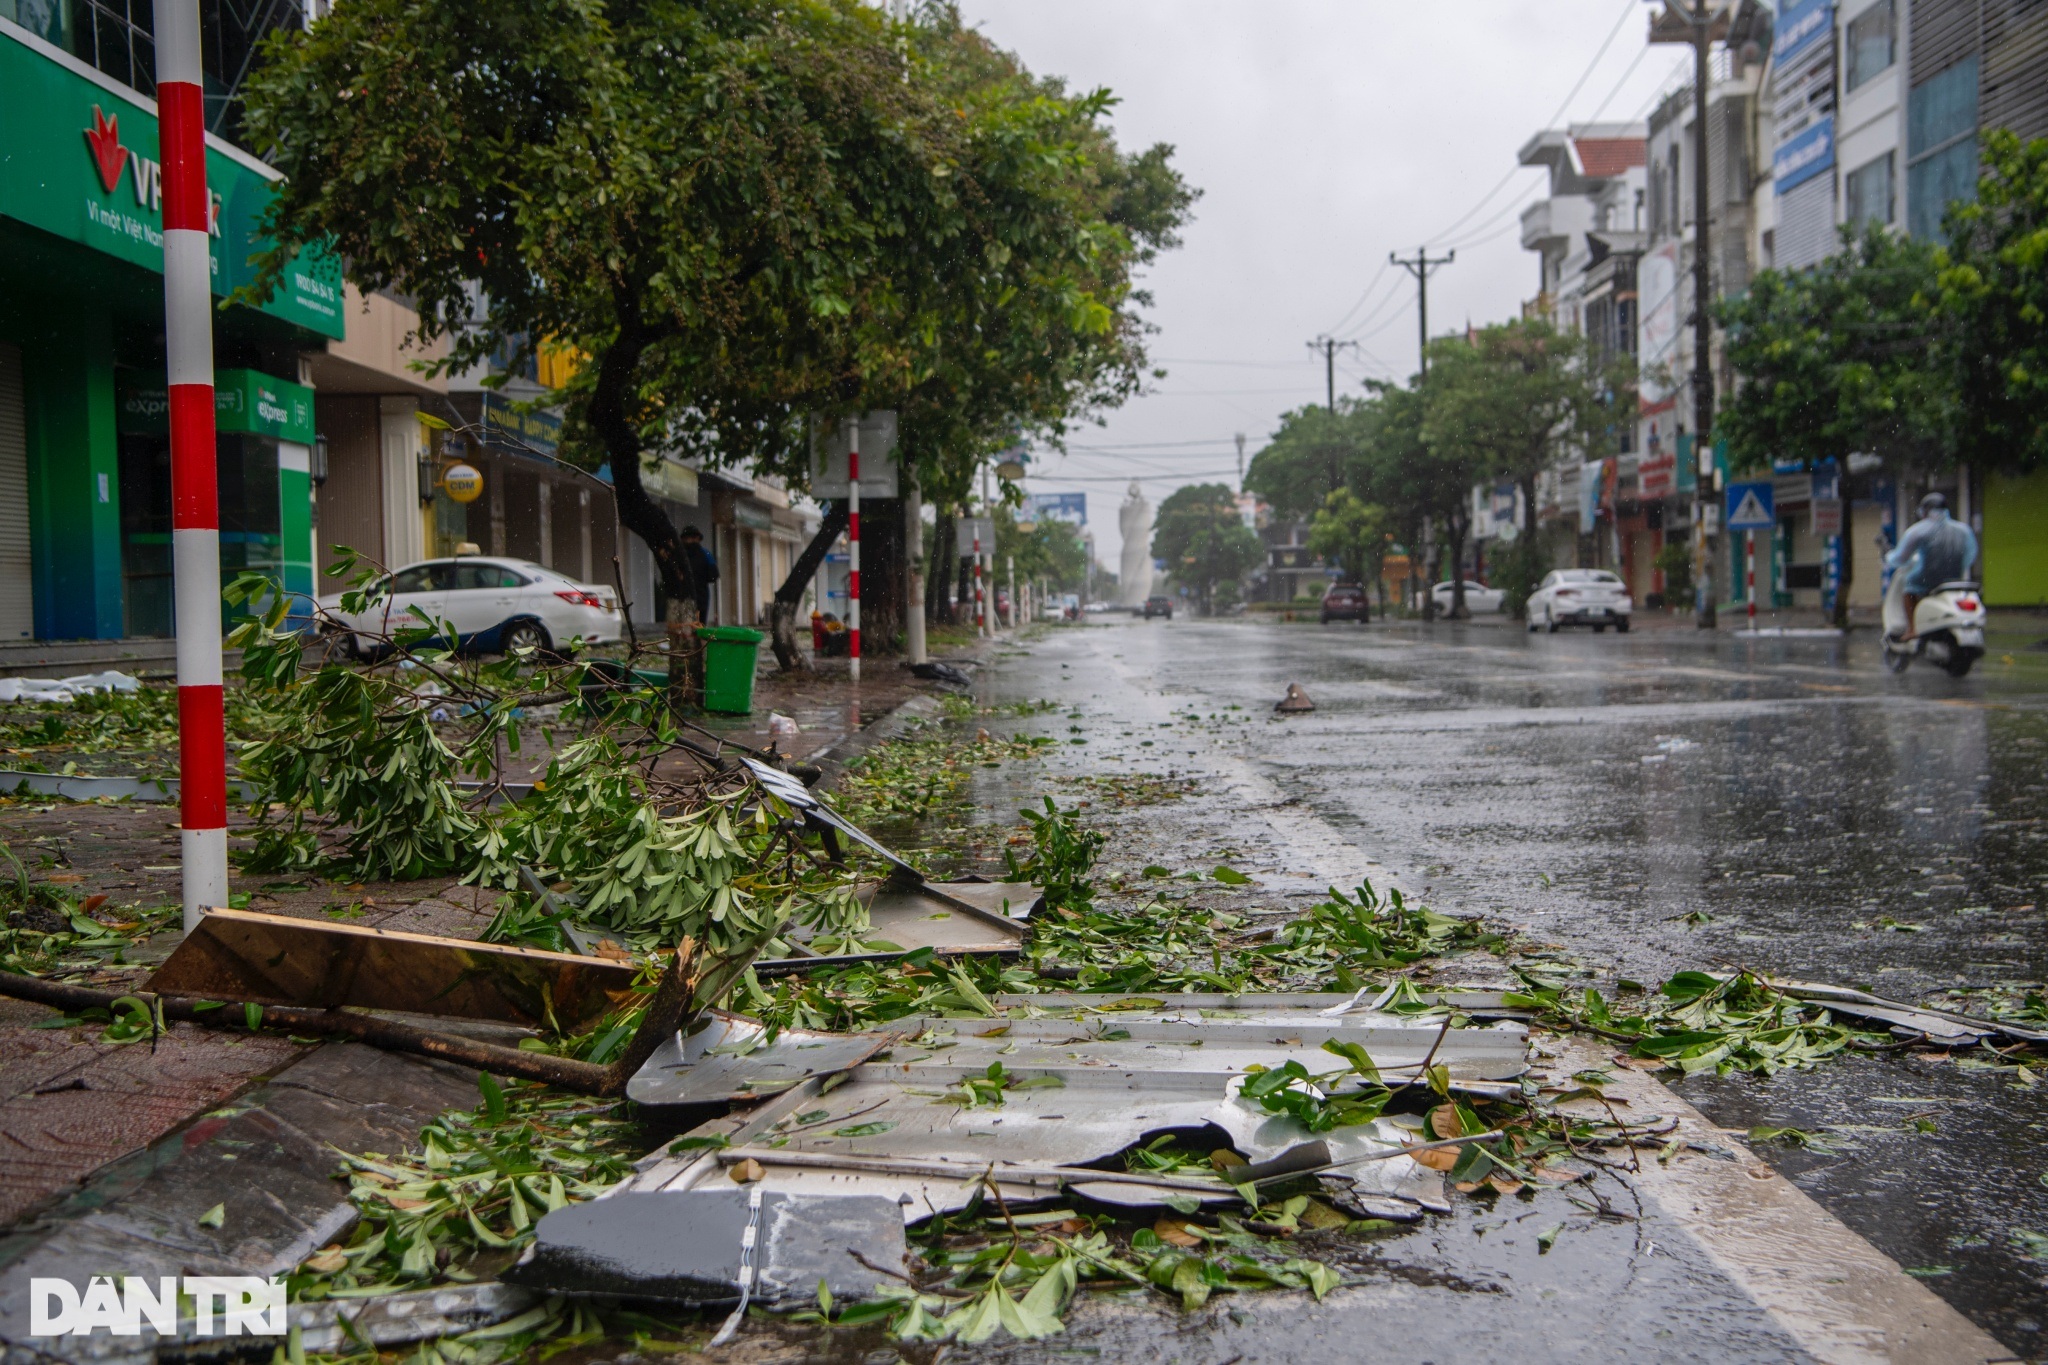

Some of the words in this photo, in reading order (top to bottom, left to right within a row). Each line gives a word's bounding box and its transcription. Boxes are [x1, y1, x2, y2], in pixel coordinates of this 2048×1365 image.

[100, 209, 122, 235] một
[122, 213, 144, 244] Việt
[450, 480, 475, 491] CDM
